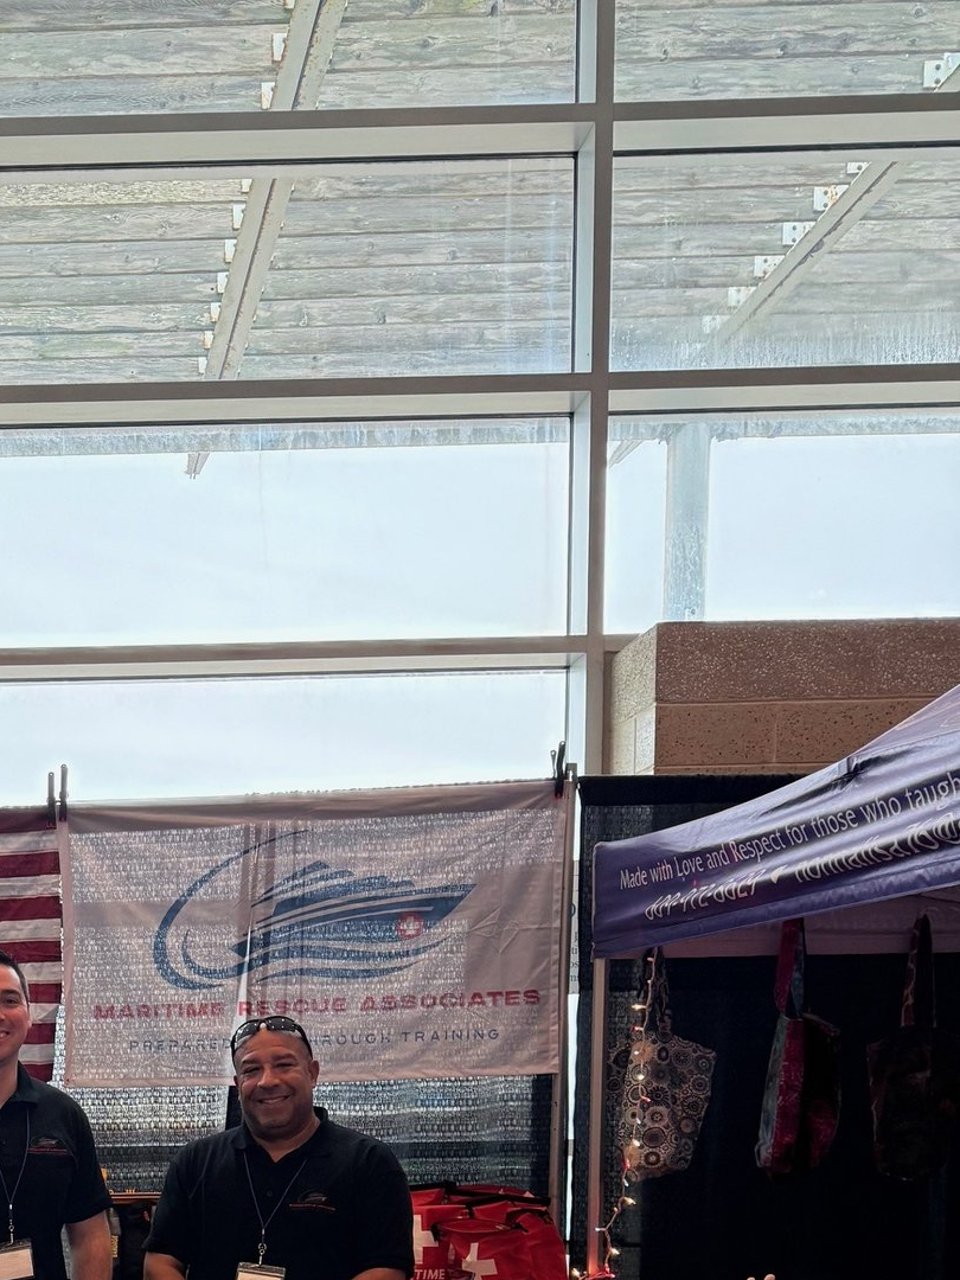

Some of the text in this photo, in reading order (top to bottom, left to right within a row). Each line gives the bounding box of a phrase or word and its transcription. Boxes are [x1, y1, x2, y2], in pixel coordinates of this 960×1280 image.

[620, 868, 648, 890] Made
[649, 858, 673, 880] with
[674, 856, 704, 877] Love
[706, 847, 730, 869] and
[730, 832, 788, 863] Respect
[785, 824, 809, 846] for
[811, 808, 859, 839] those
[860, 795, 902, 824] who
[93, 989, 540, 1020] MARITIME RESCUE ASSOCIATES
[309, 1033, 390, 1046] HROUGH
[401, 1029, 499, 1042] TRAINING
[414, 1268, 445, 1280] TIME
